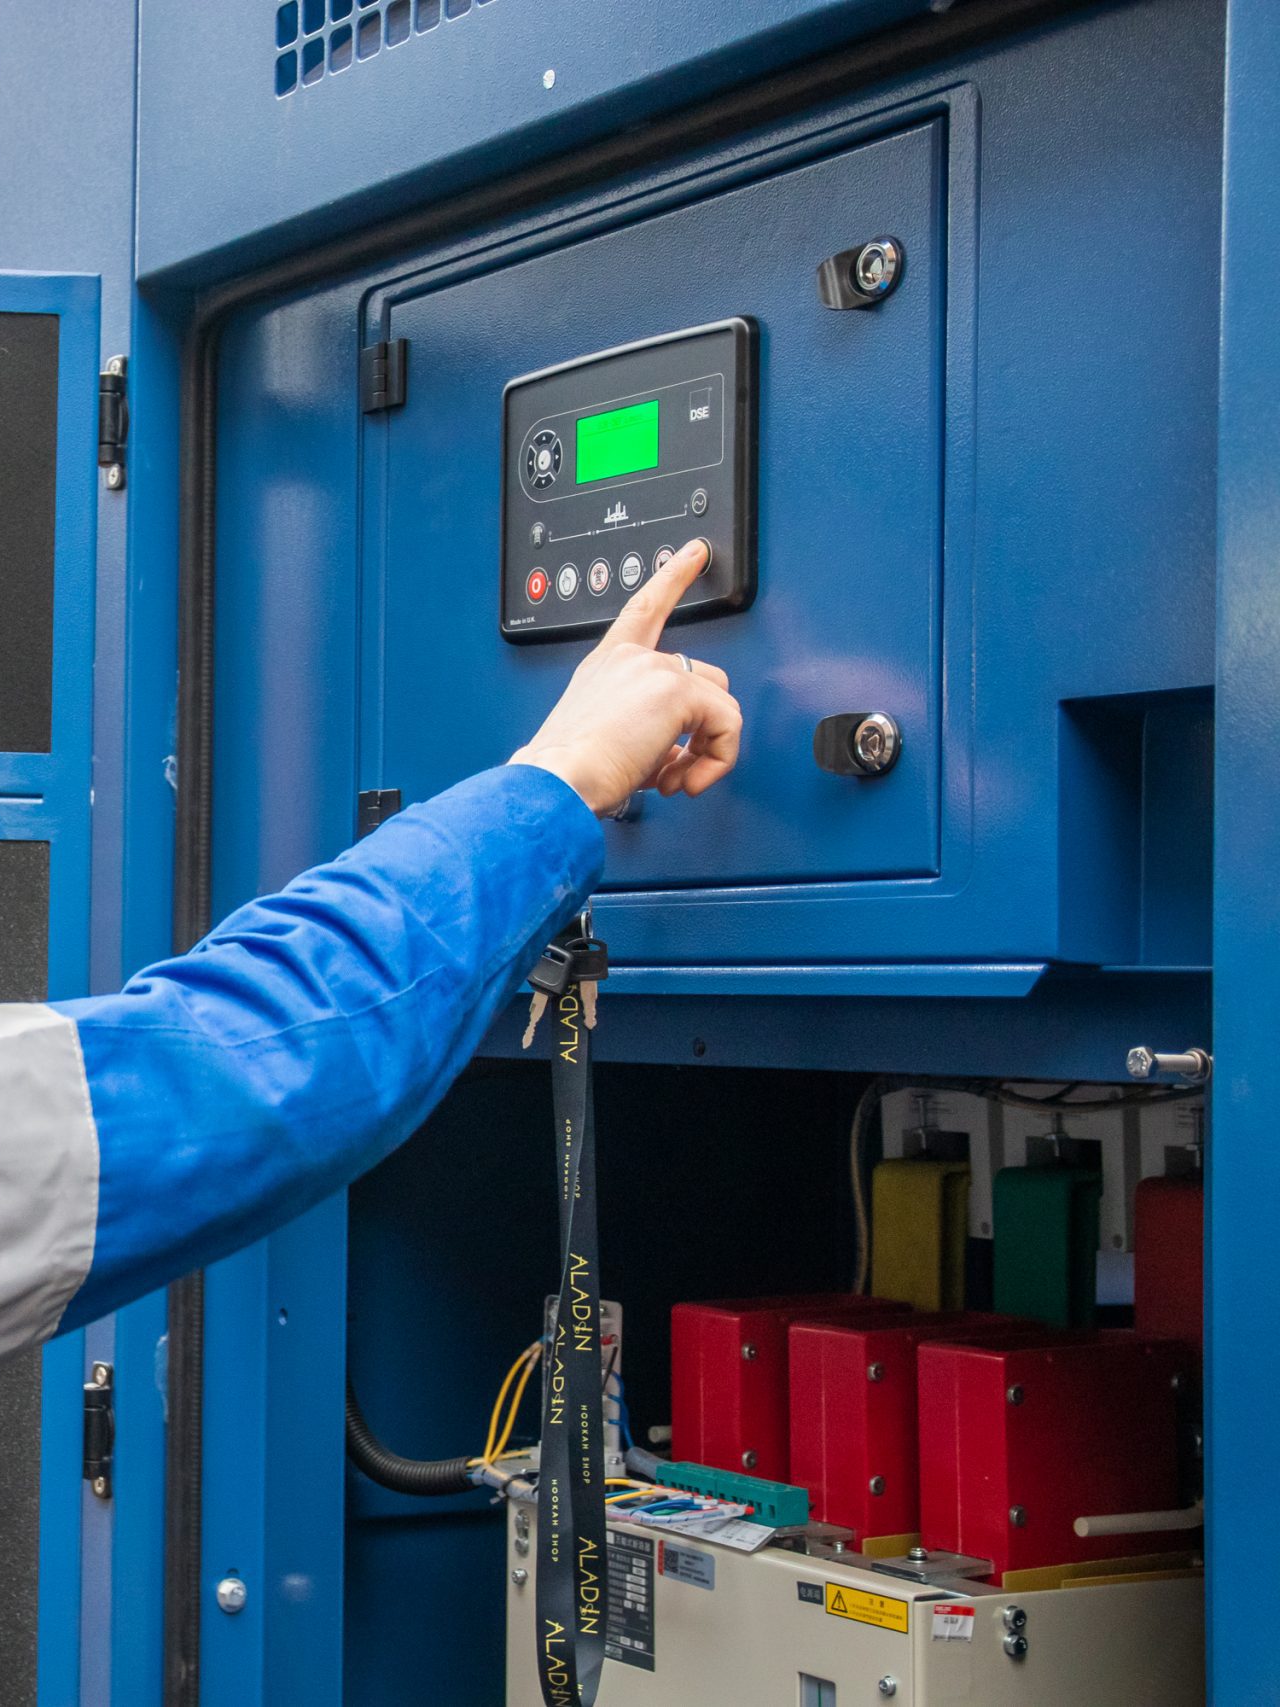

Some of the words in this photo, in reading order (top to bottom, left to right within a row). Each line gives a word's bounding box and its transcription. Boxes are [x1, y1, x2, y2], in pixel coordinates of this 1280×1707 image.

[689, 406, 709, 421] DSE
[560, 985, 578, 1064] ALAD
[570, 1253, 592, 1351] ALADIN
[550, 1324, 567, 1424] ALADIN
[580, 1404, 590, 1450] HOOKAH
[582, 1457, 591, 1484] SHOP
[551, 1479, 559, 1526] HOOKAH
[551, 1533, 559, 1562] SHOP
[578, 1536, 600, 1634] ALADIN
